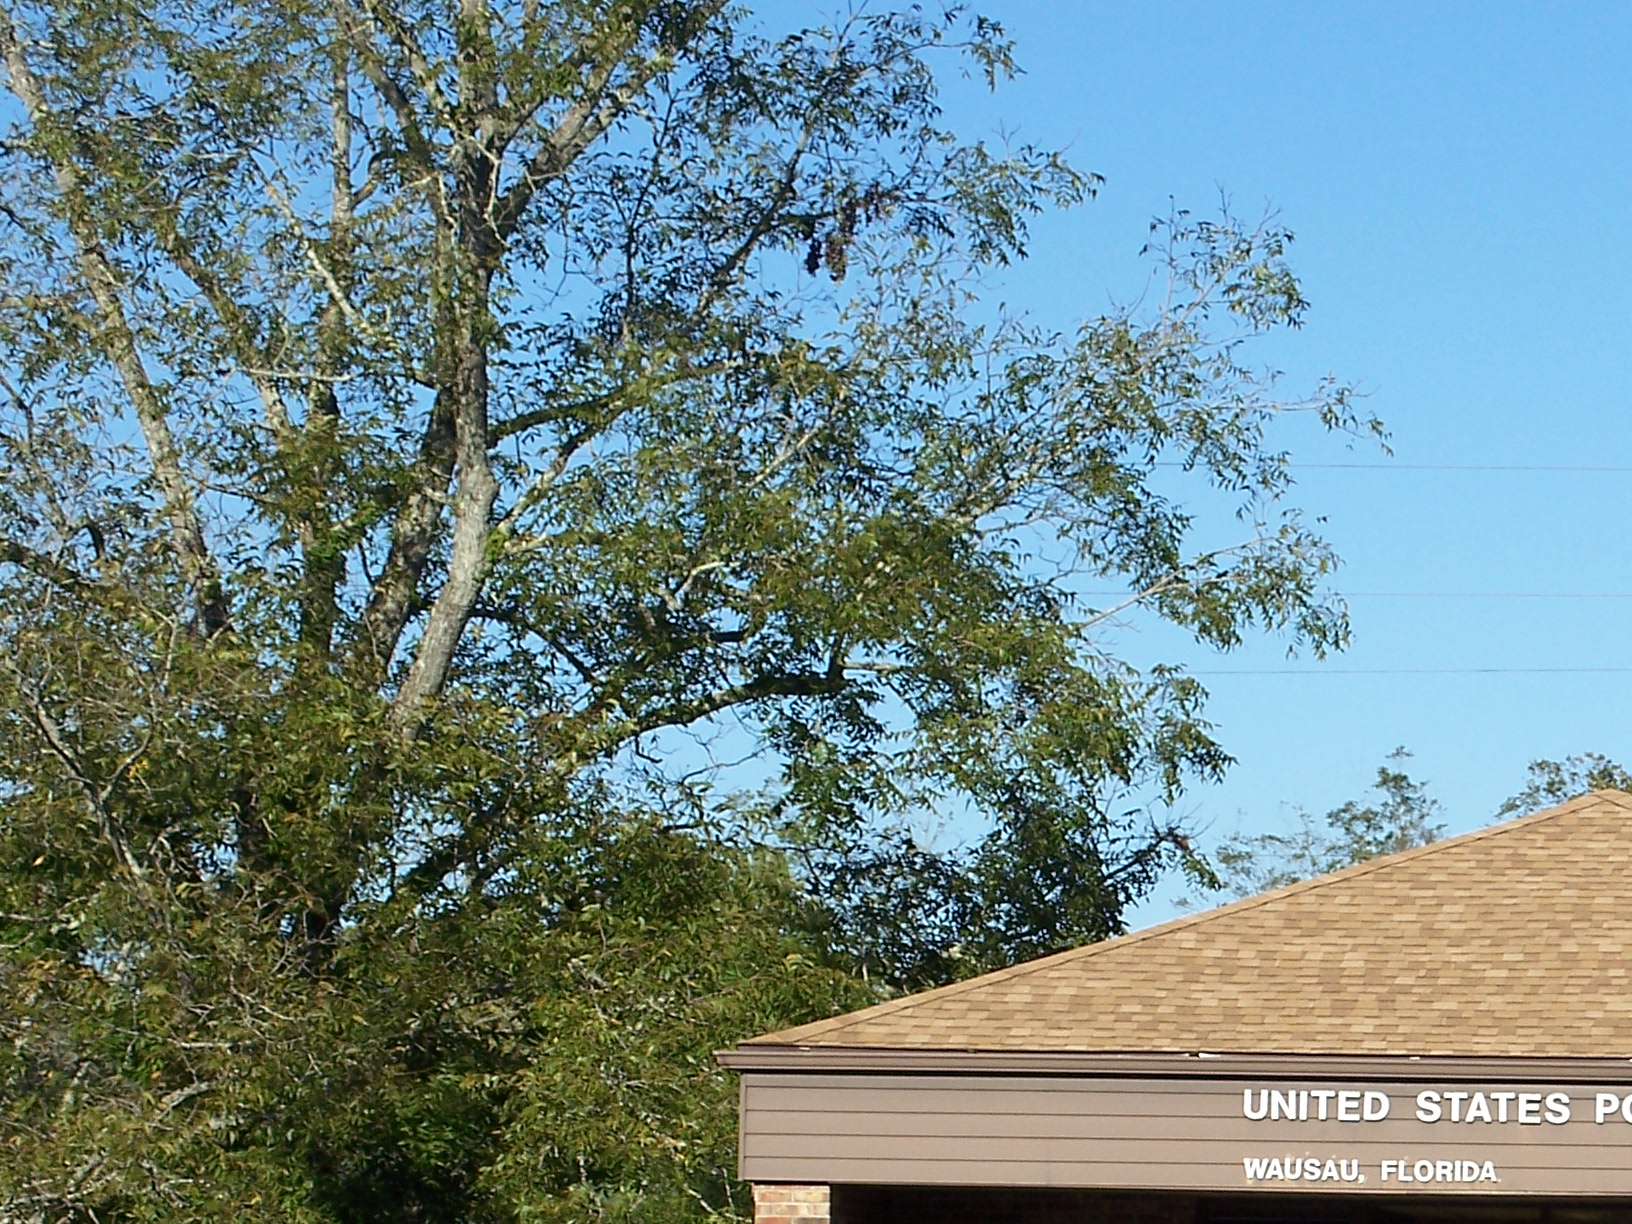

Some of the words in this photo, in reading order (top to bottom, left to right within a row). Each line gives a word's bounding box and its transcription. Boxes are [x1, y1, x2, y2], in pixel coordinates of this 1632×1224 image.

[1242, 1088, 1391, 1122] UNITED
[1414, 1090, 1572, 1125] STATES
[1242, 1156, 1366, 1184] WAUSAU,
[1380, 1158, 1499, 1183] FLORIDA
